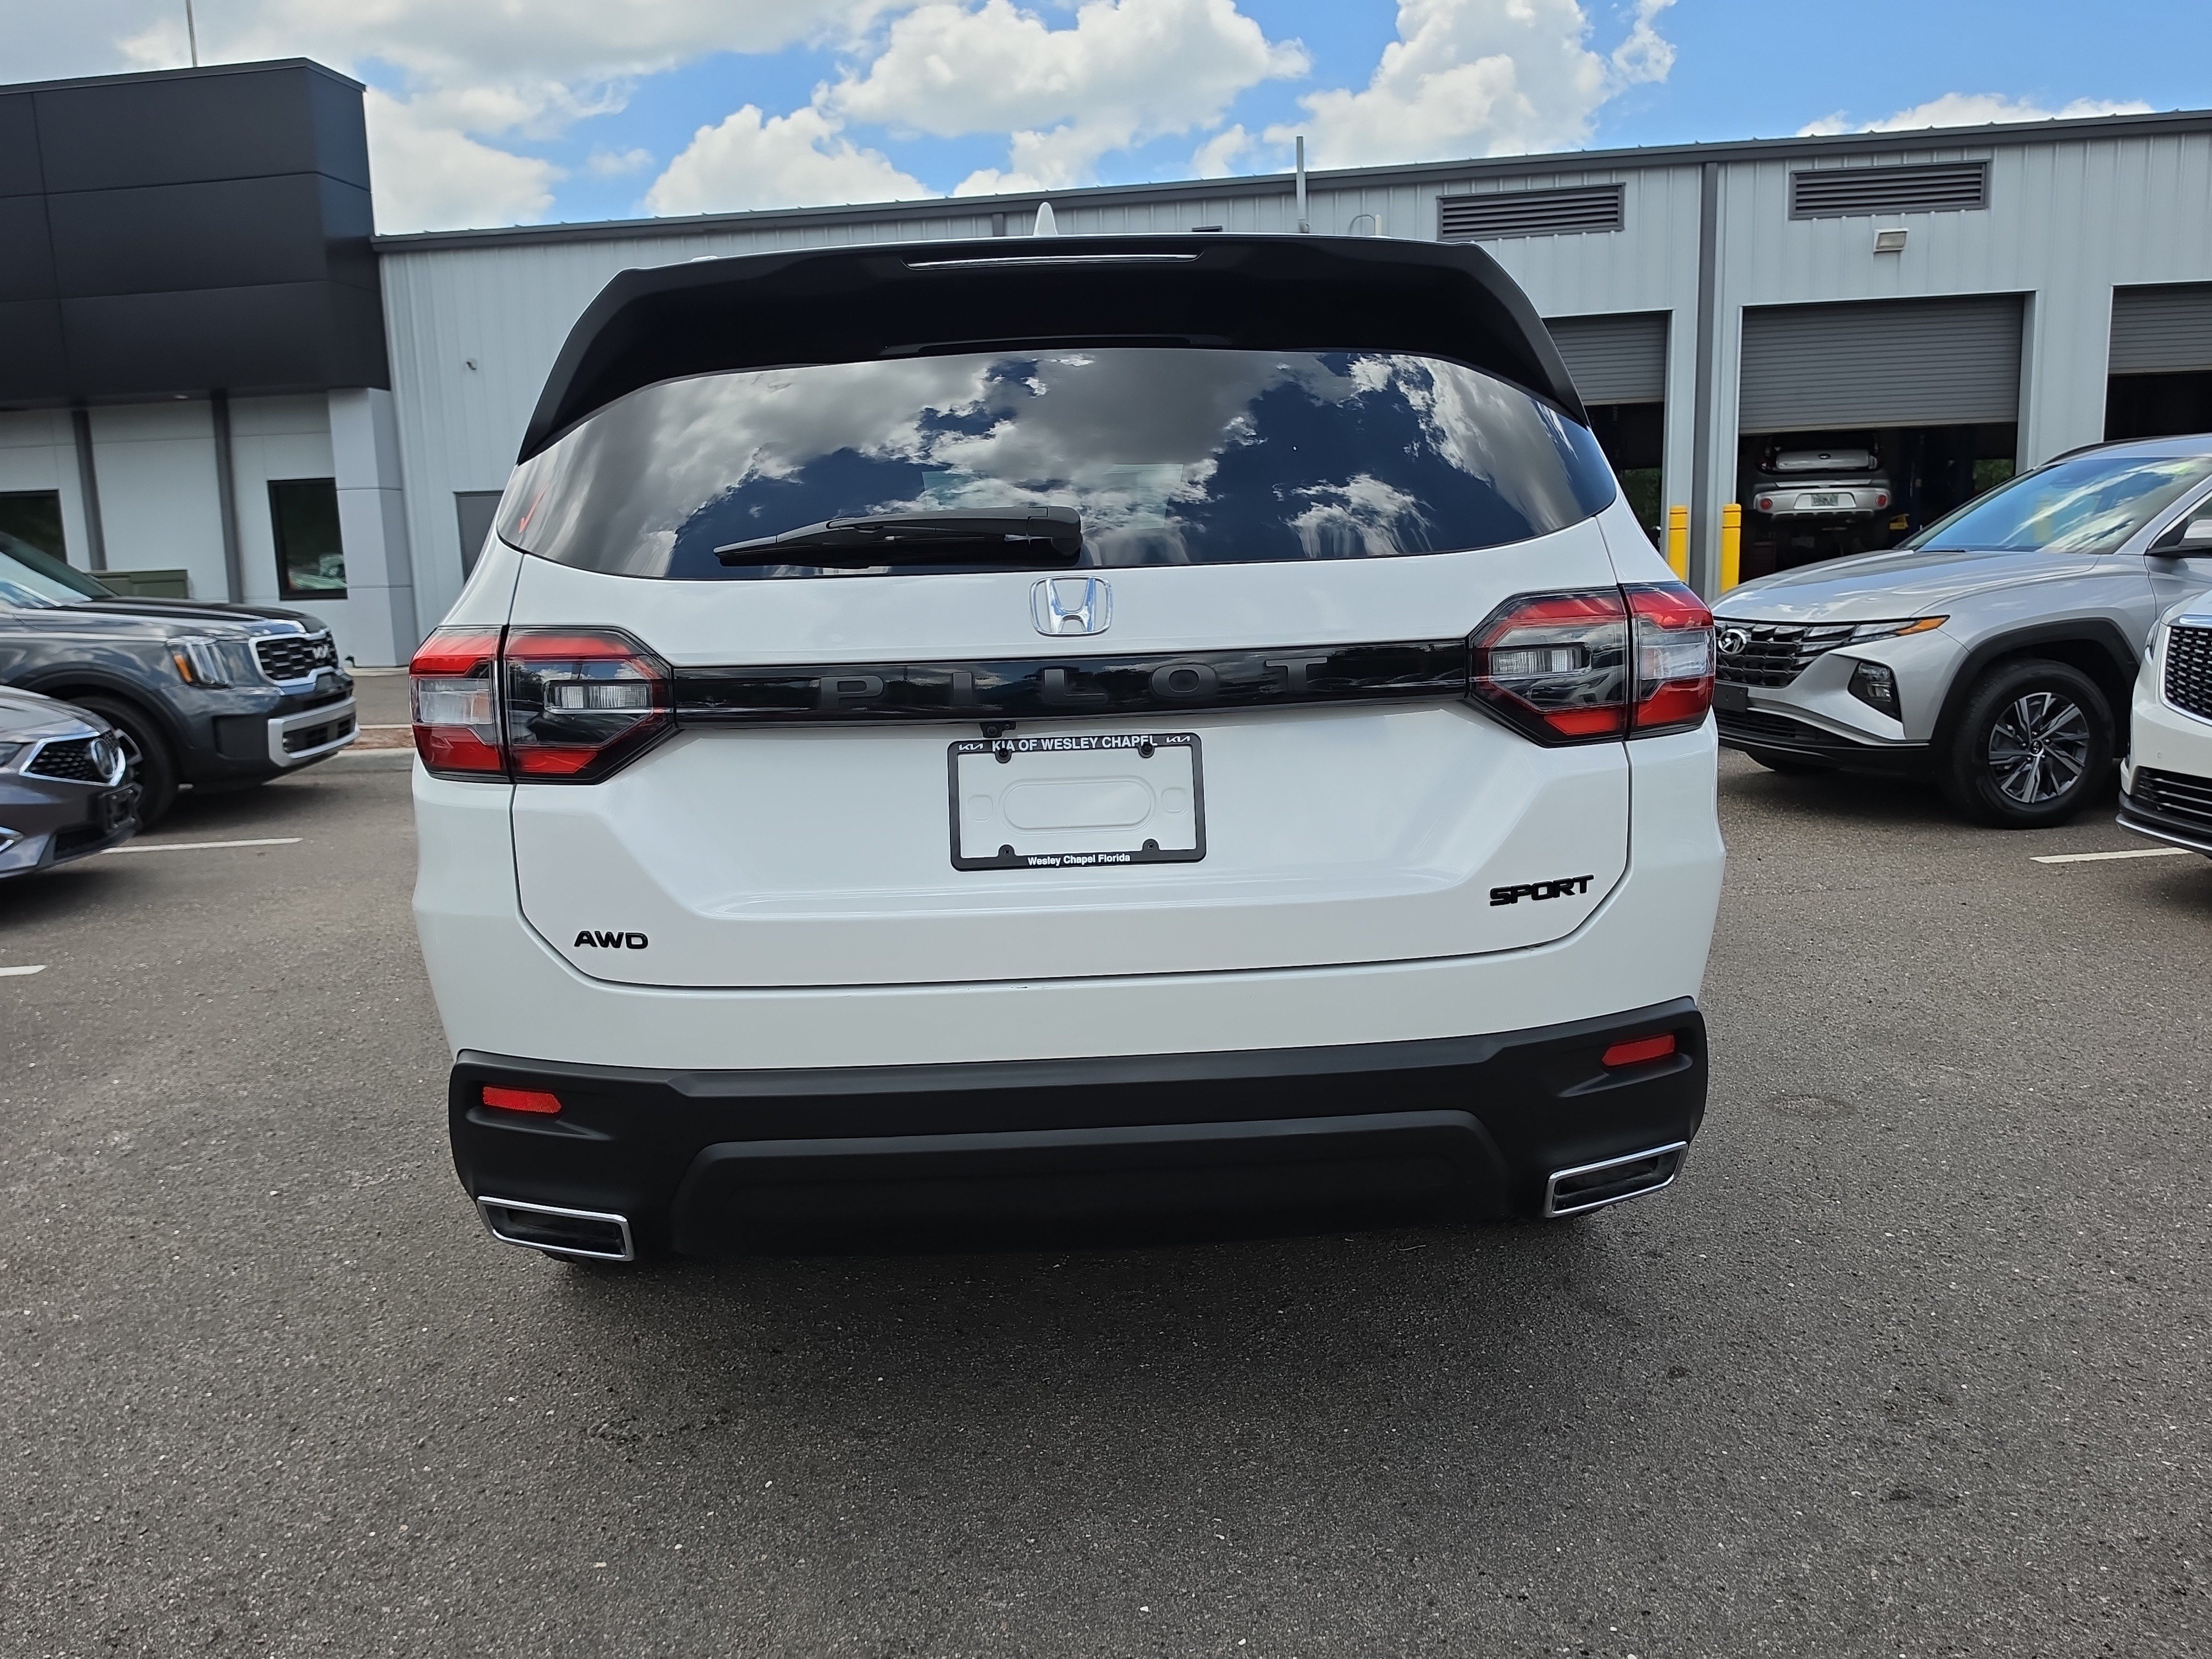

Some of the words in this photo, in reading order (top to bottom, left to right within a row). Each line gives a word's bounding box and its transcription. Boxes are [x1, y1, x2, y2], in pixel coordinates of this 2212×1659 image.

[820, 657, 1328, 709] PILOT
[992, 740, 1015, 752] KIA
[1018, 739, 1038, 751] OF
[1041, 737, 1098, 750] WESLEY
[1027, 856, 1061, 866] Wesley
[1063, 854, 1096, 865] Chapel
[1098, 853, 1130, 863] Florida
[1489, 874, 1594, 906] SPORT
[574, 930, 648, 949] AWD
